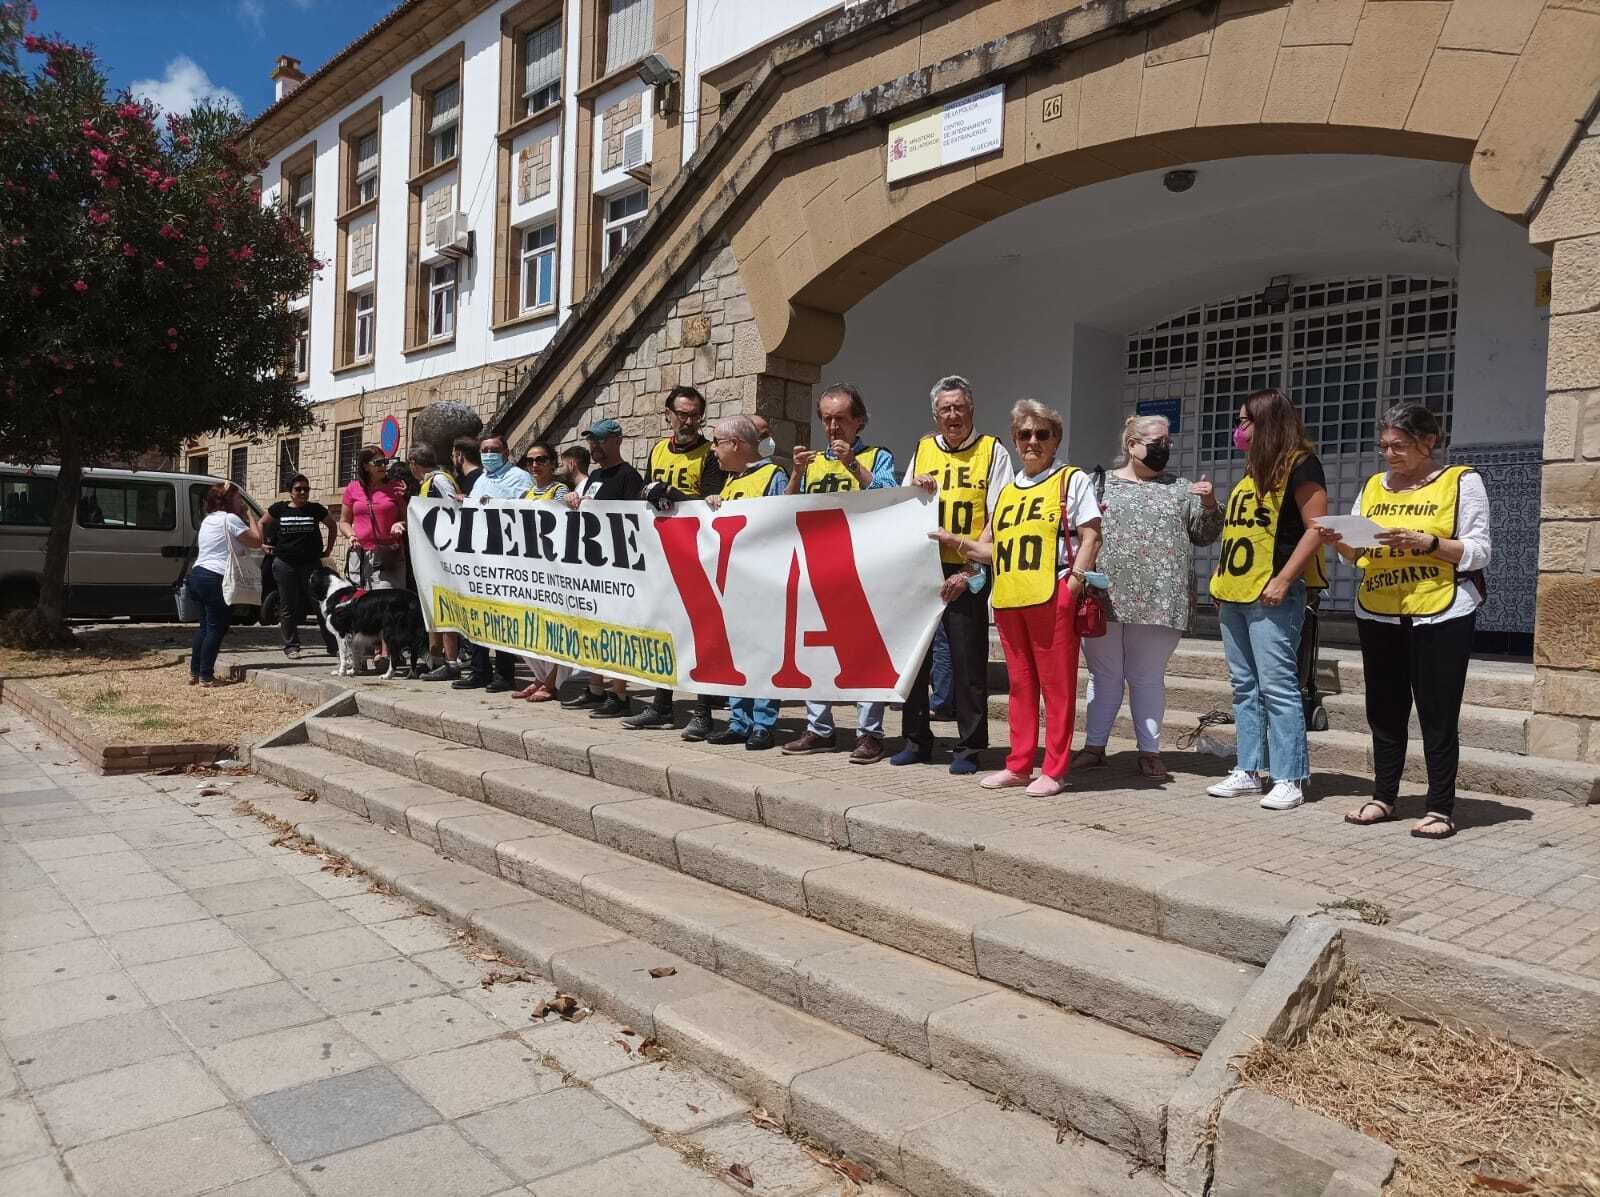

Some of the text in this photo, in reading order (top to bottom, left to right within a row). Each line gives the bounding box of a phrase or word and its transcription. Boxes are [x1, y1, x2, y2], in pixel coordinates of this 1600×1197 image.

[1045, 98, 1060, 117] 46
[910, 132, 935, 145] MINISTERIO
[944, 120, 965, 131] CENTRO
[951, 118, 992, 137] INTERNAMIENTO
[971, 136, 999, 152] ALGECIRAS
[1366, 500, 1439, 518] CONSTRUIR
[422, 506, 646, 571] CIERRE
[996, 535, 1042, 576] NO
[450, 562, 470, 576] LOS
[474, 563, 528, 581] CENTROS
[532, 571, 545, 585] DE
[547, 573, 635, 598] INTERNAMIENTO
[1366, 566, 1439, 592] DESPILFARRO
[469, 581, 598, 615] DE EXTRANJEROS (CIEs)
[653, 508, 900, 689] YA
[483, 607, 519, 645] PIÑERA
[525, 608, 540, 649] NI
[545, 621, 580, 659] NUEVO
[583, 635, 600, 660] EN
[600, 629, 674, 676] BOTAFUEGO
